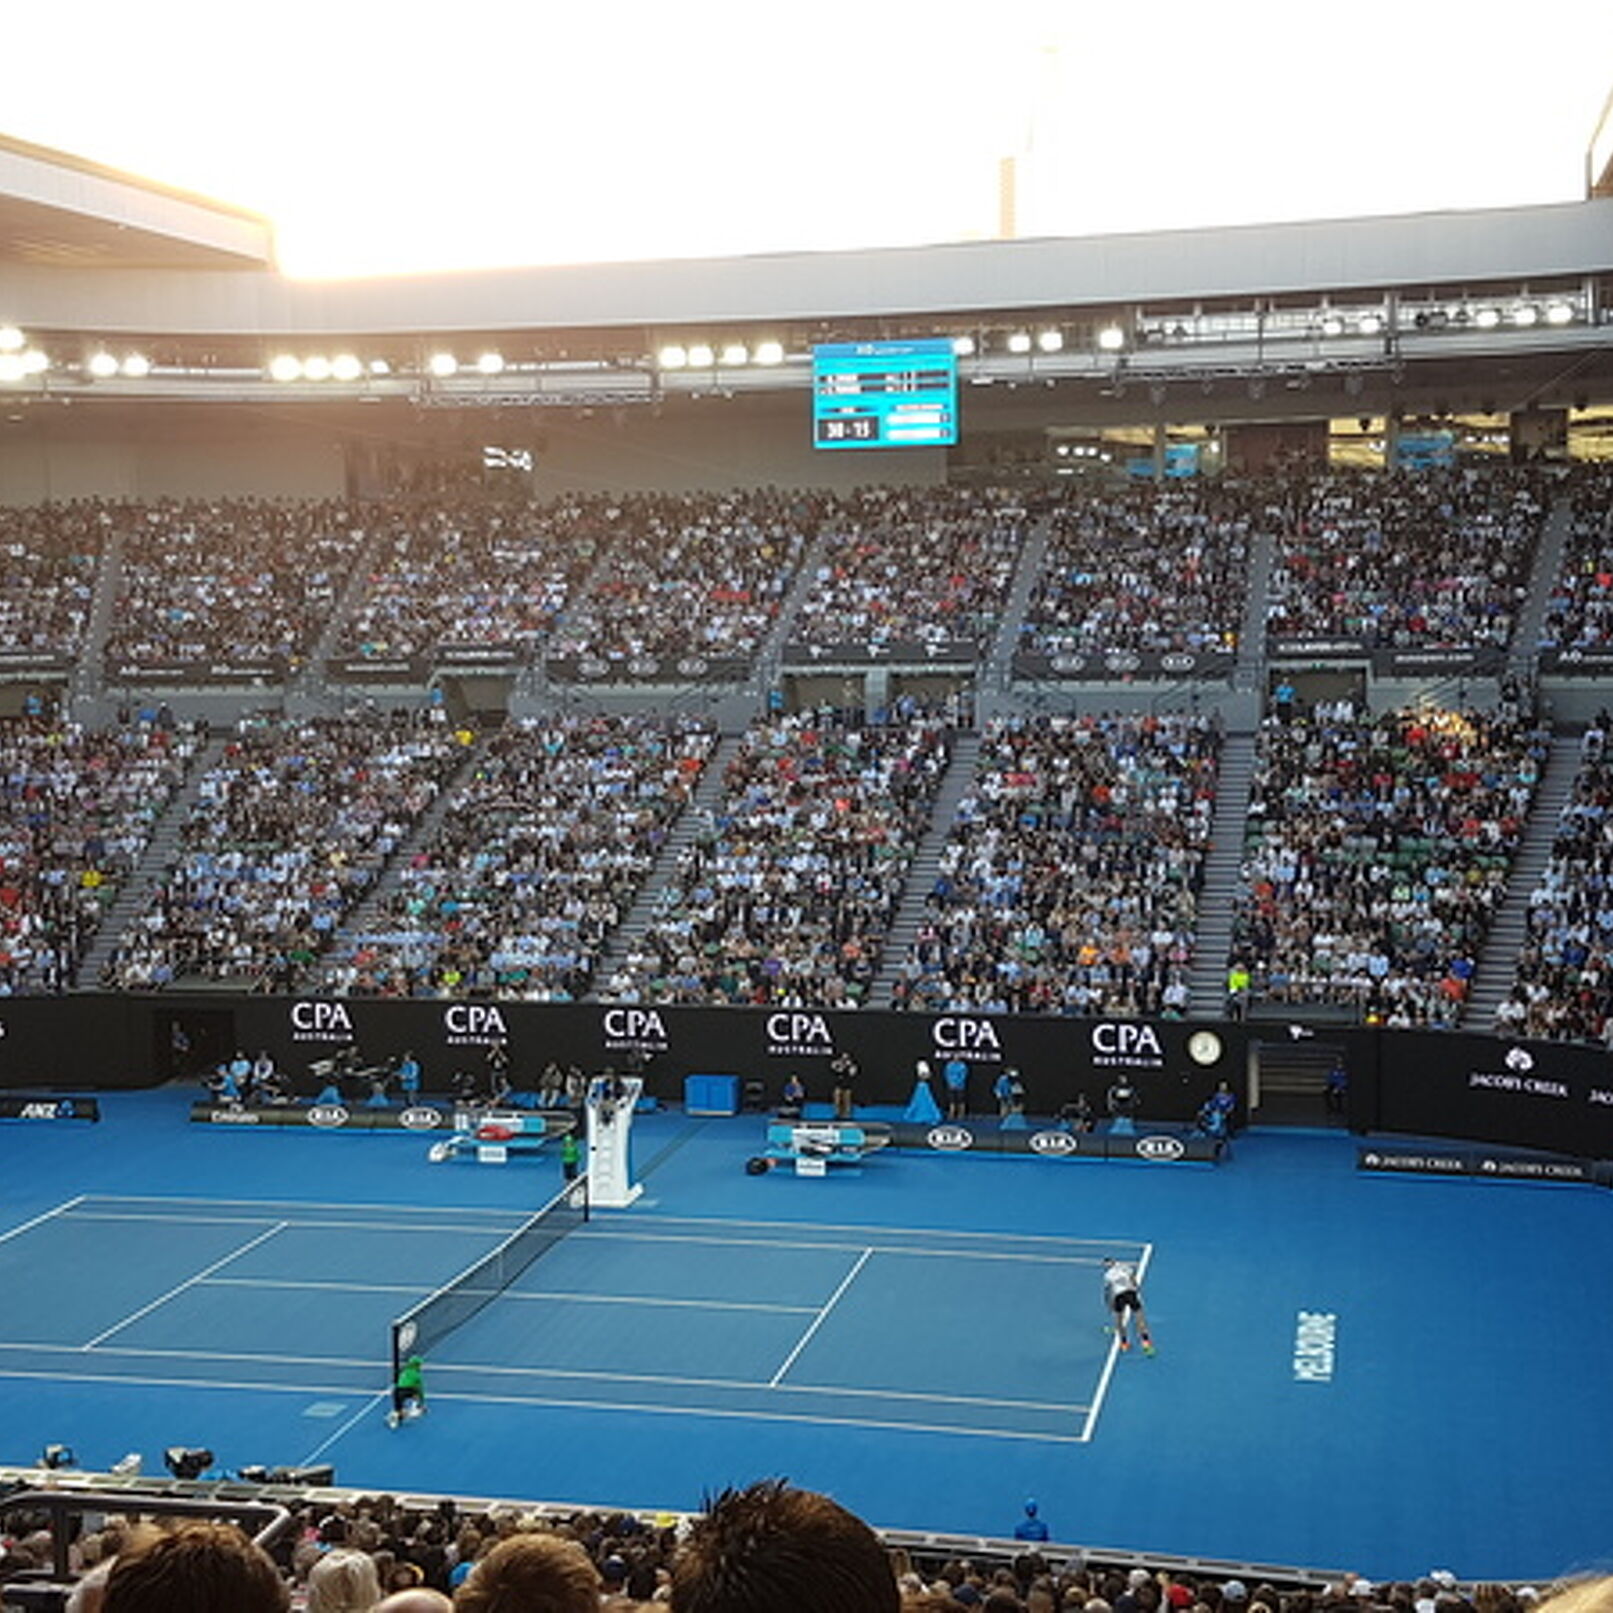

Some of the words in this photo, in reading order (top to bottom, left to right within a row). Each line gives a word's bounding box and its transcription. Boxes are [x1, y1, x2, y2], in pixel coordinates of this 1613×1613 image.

[292, 1002, 352, 1030] CPA
[446, 1006, 507, 1033] CPA
[604, 1010, 666, 1037] CPA
[767, 1014, 832, 1042] CPA
[933, 1018, 999, 1048] CPA
[1093, 1024, 1161, 1054] CPA
[21, 1103, 57, 1118] ANZ
